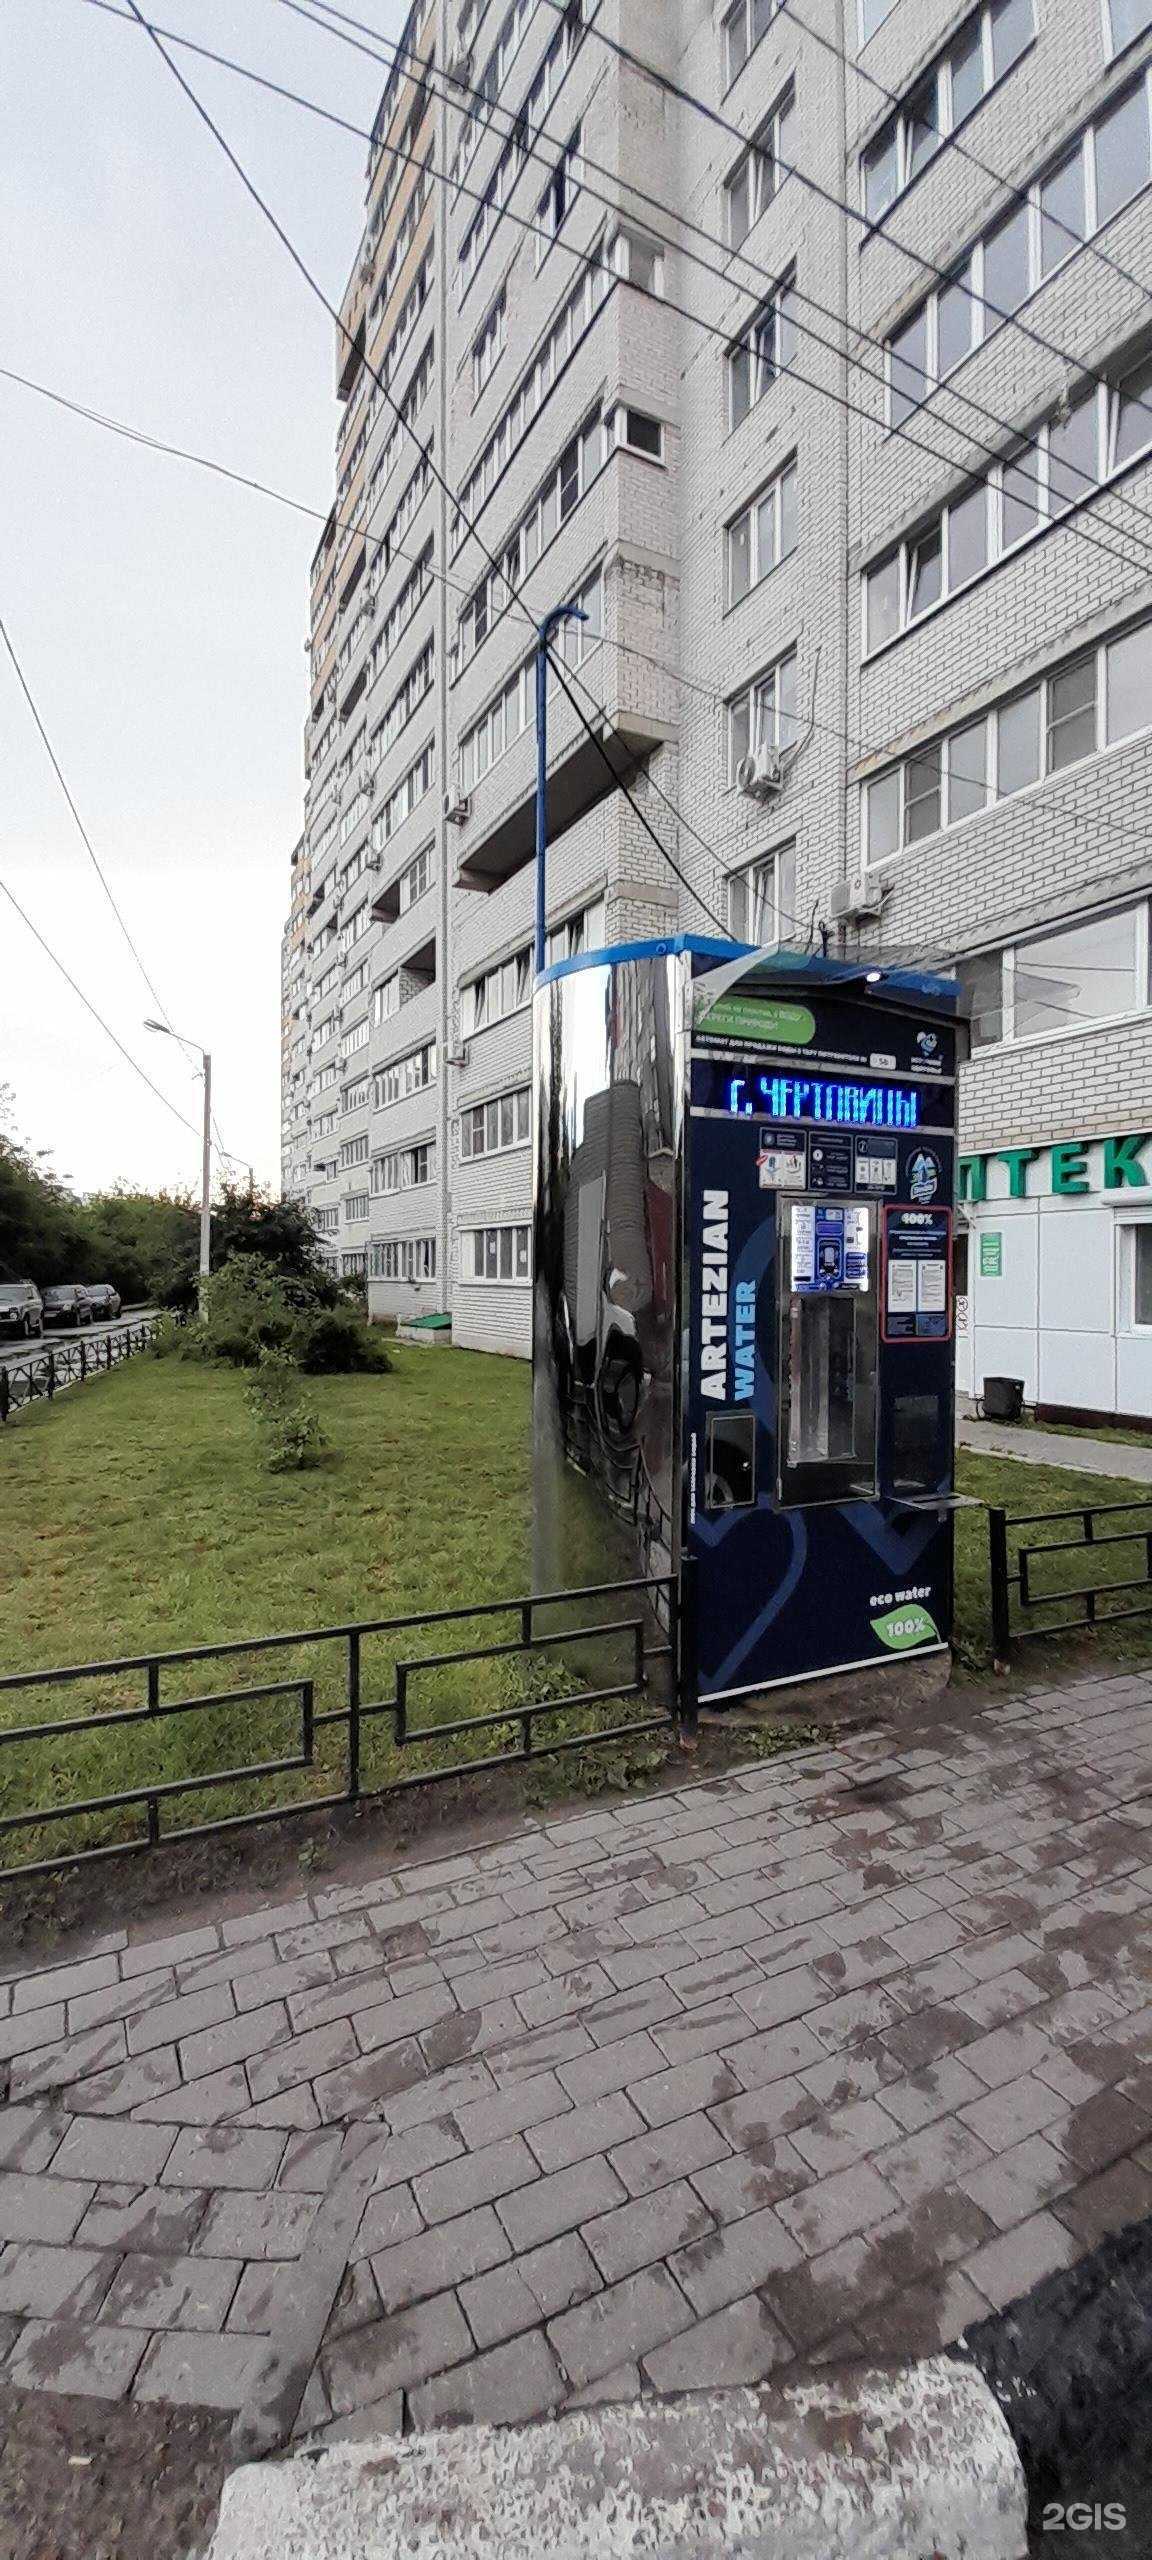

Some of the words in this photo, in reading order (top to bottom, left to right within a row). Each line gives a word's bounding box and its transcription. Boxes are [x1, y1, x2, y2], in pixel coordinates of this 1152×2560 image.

[700, 1189, 729, 1401] ARTEZIAN
[734, 1279, 756, 1402] WATER
[869, 1593, 893, 1607] eco
[894, 1586, 932, 1602] water
[886, 1617, 925, 1639] 100%
